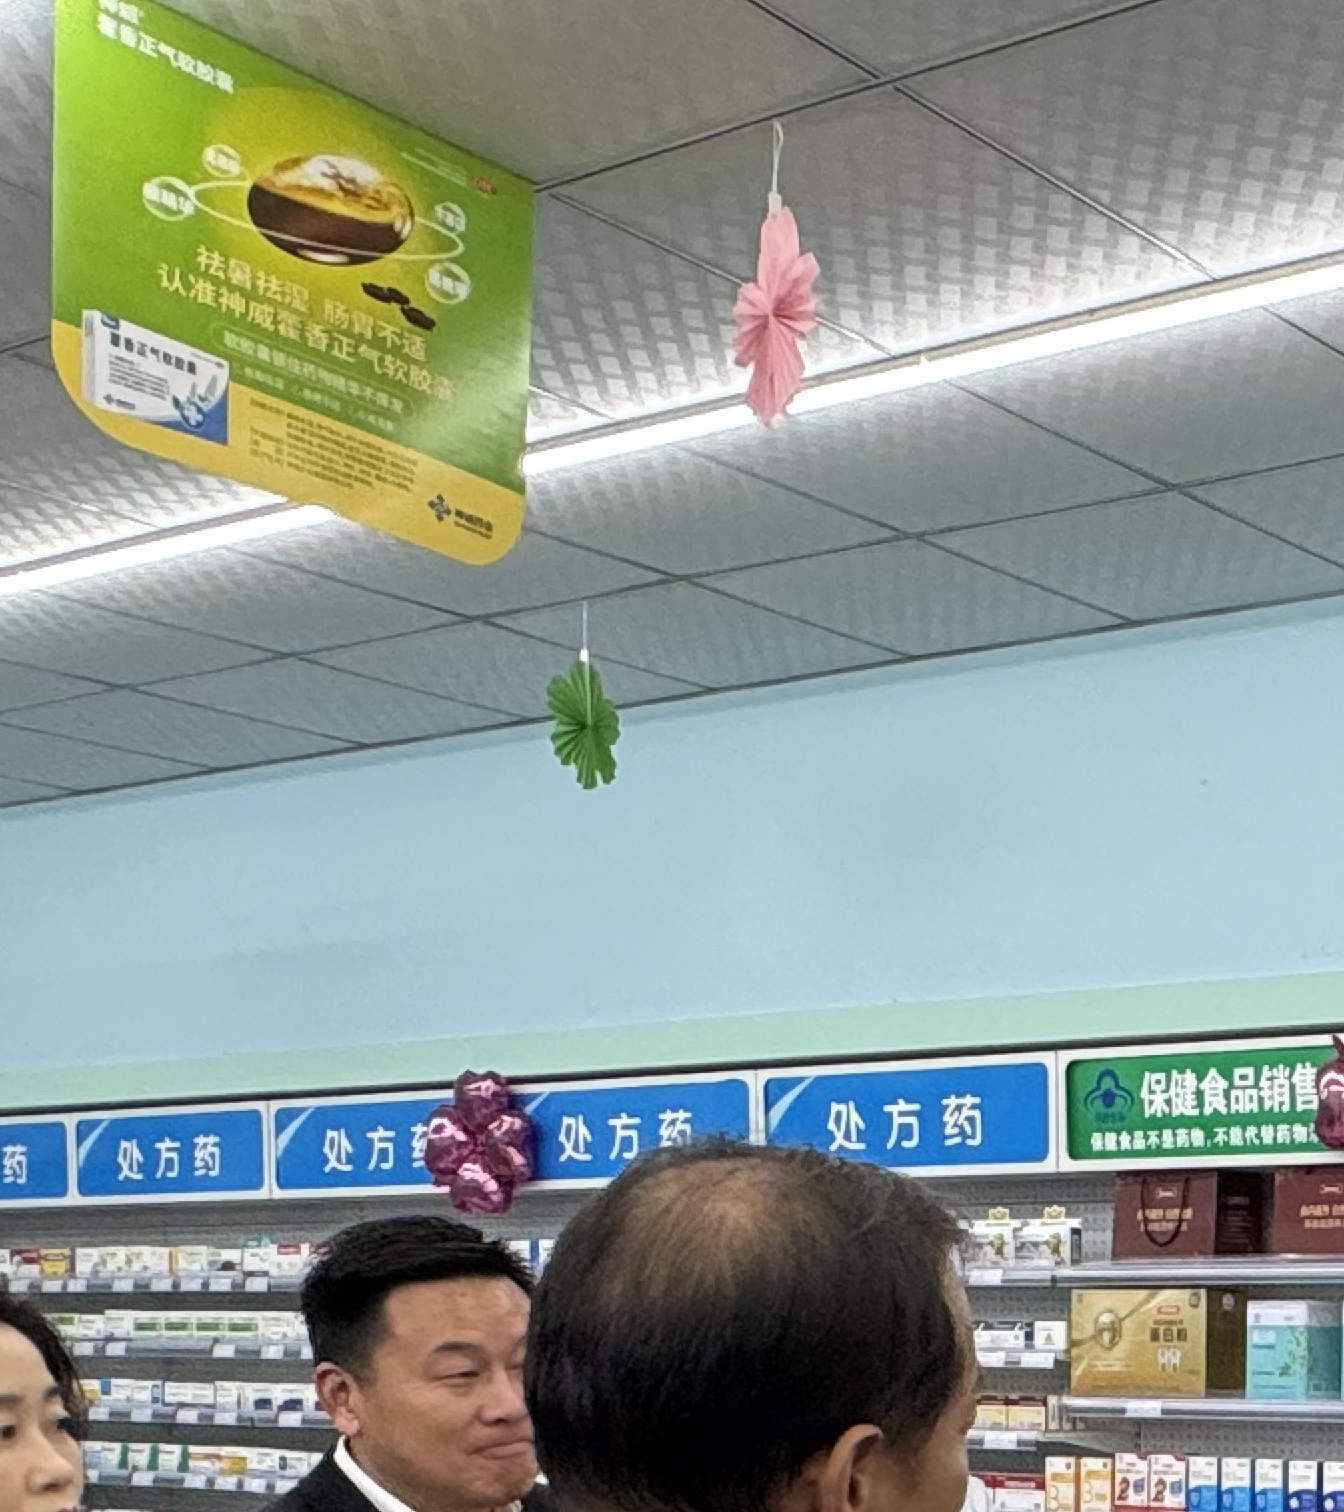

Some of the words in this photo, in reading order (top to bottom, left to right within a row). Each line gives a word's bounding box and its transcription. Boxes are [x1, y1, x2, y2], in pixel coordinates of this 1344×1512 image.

[1141, 1062, 1319, 1118] 保健食品销售
[558, 1109, 693, 1161] 处方药
[827, 1094, 983, 1151] 处方药
[117, 1134, 221, 1181] 处方药
